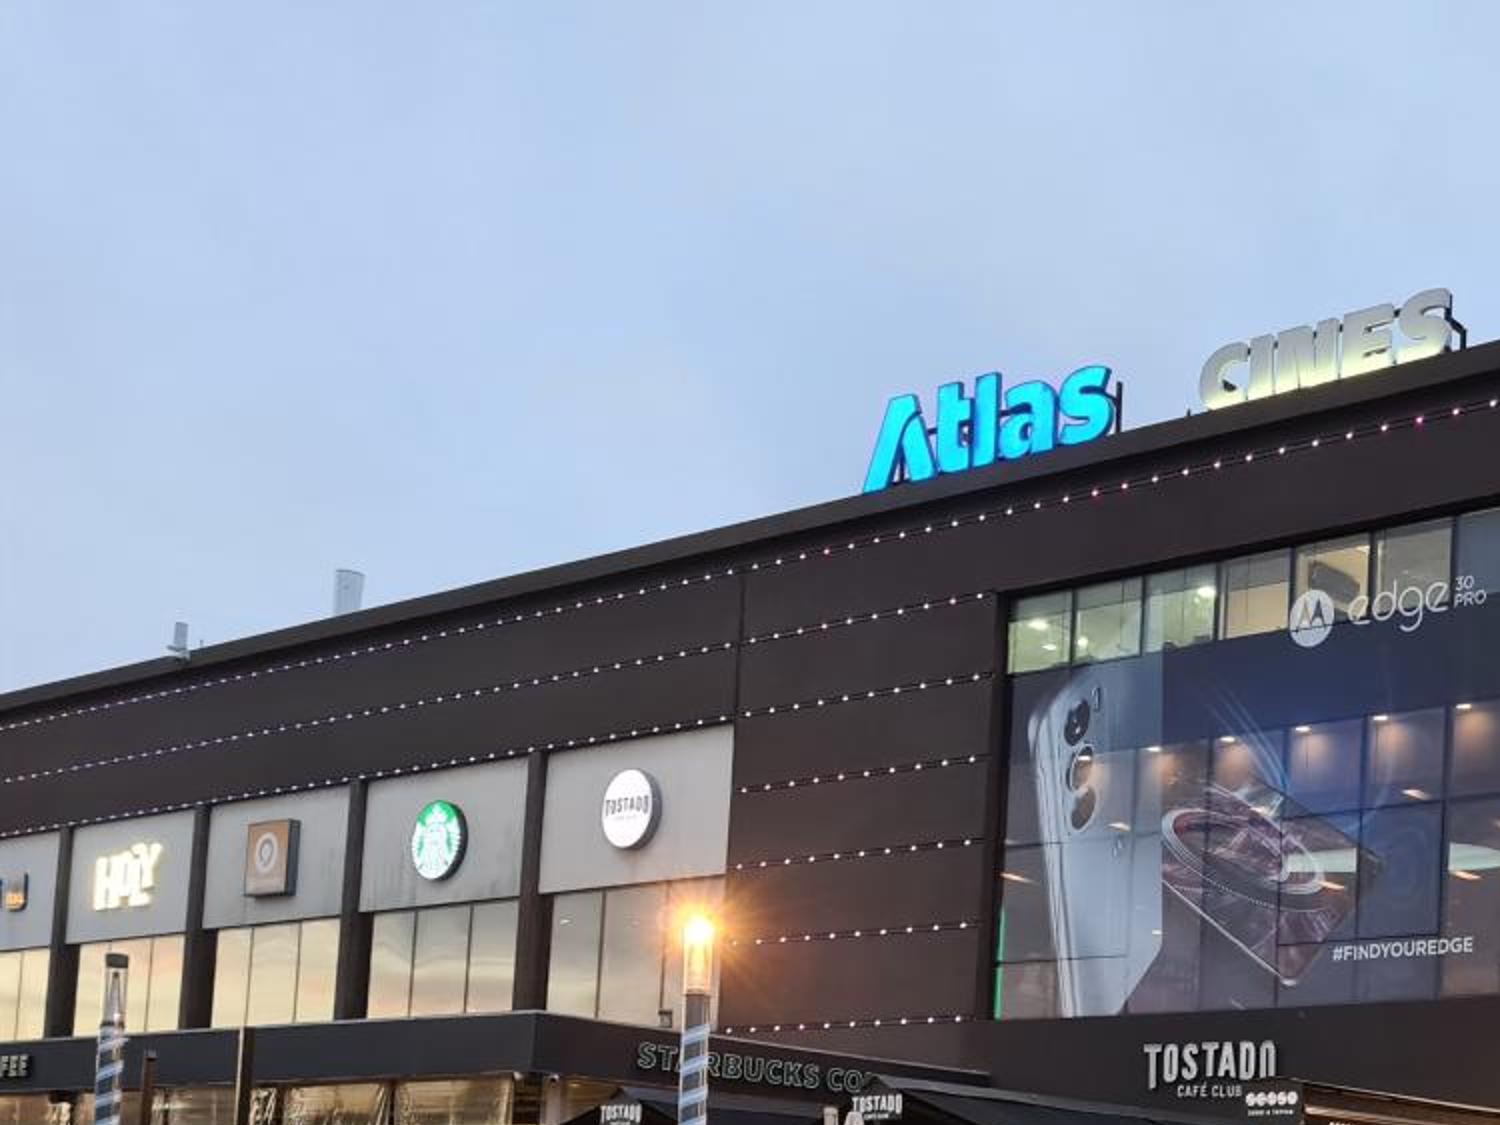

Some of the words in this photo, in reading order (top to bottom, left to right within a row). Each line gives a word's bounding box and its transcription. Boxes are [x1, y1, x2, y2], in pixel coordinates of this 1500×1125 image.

[1200, 288, 1456, 412] CINES
[863, 365, 1119, 493] Atlas
[1349, 579, 1448, 632] edge
[1454, 589, 1487, 608] PRO
[1455, 575, 1475, 591] 30
[1332, 937, 1473, 961] #FINDYOUREDGE
[637, 1041, 820, 1088] STRBUCKS
[1144, 1040, 1276, 1090] TOSTADO
[1177, 1081, 1207, 1098] CAFÉ
[1211, 1084, 1242, 1098] CLUB
